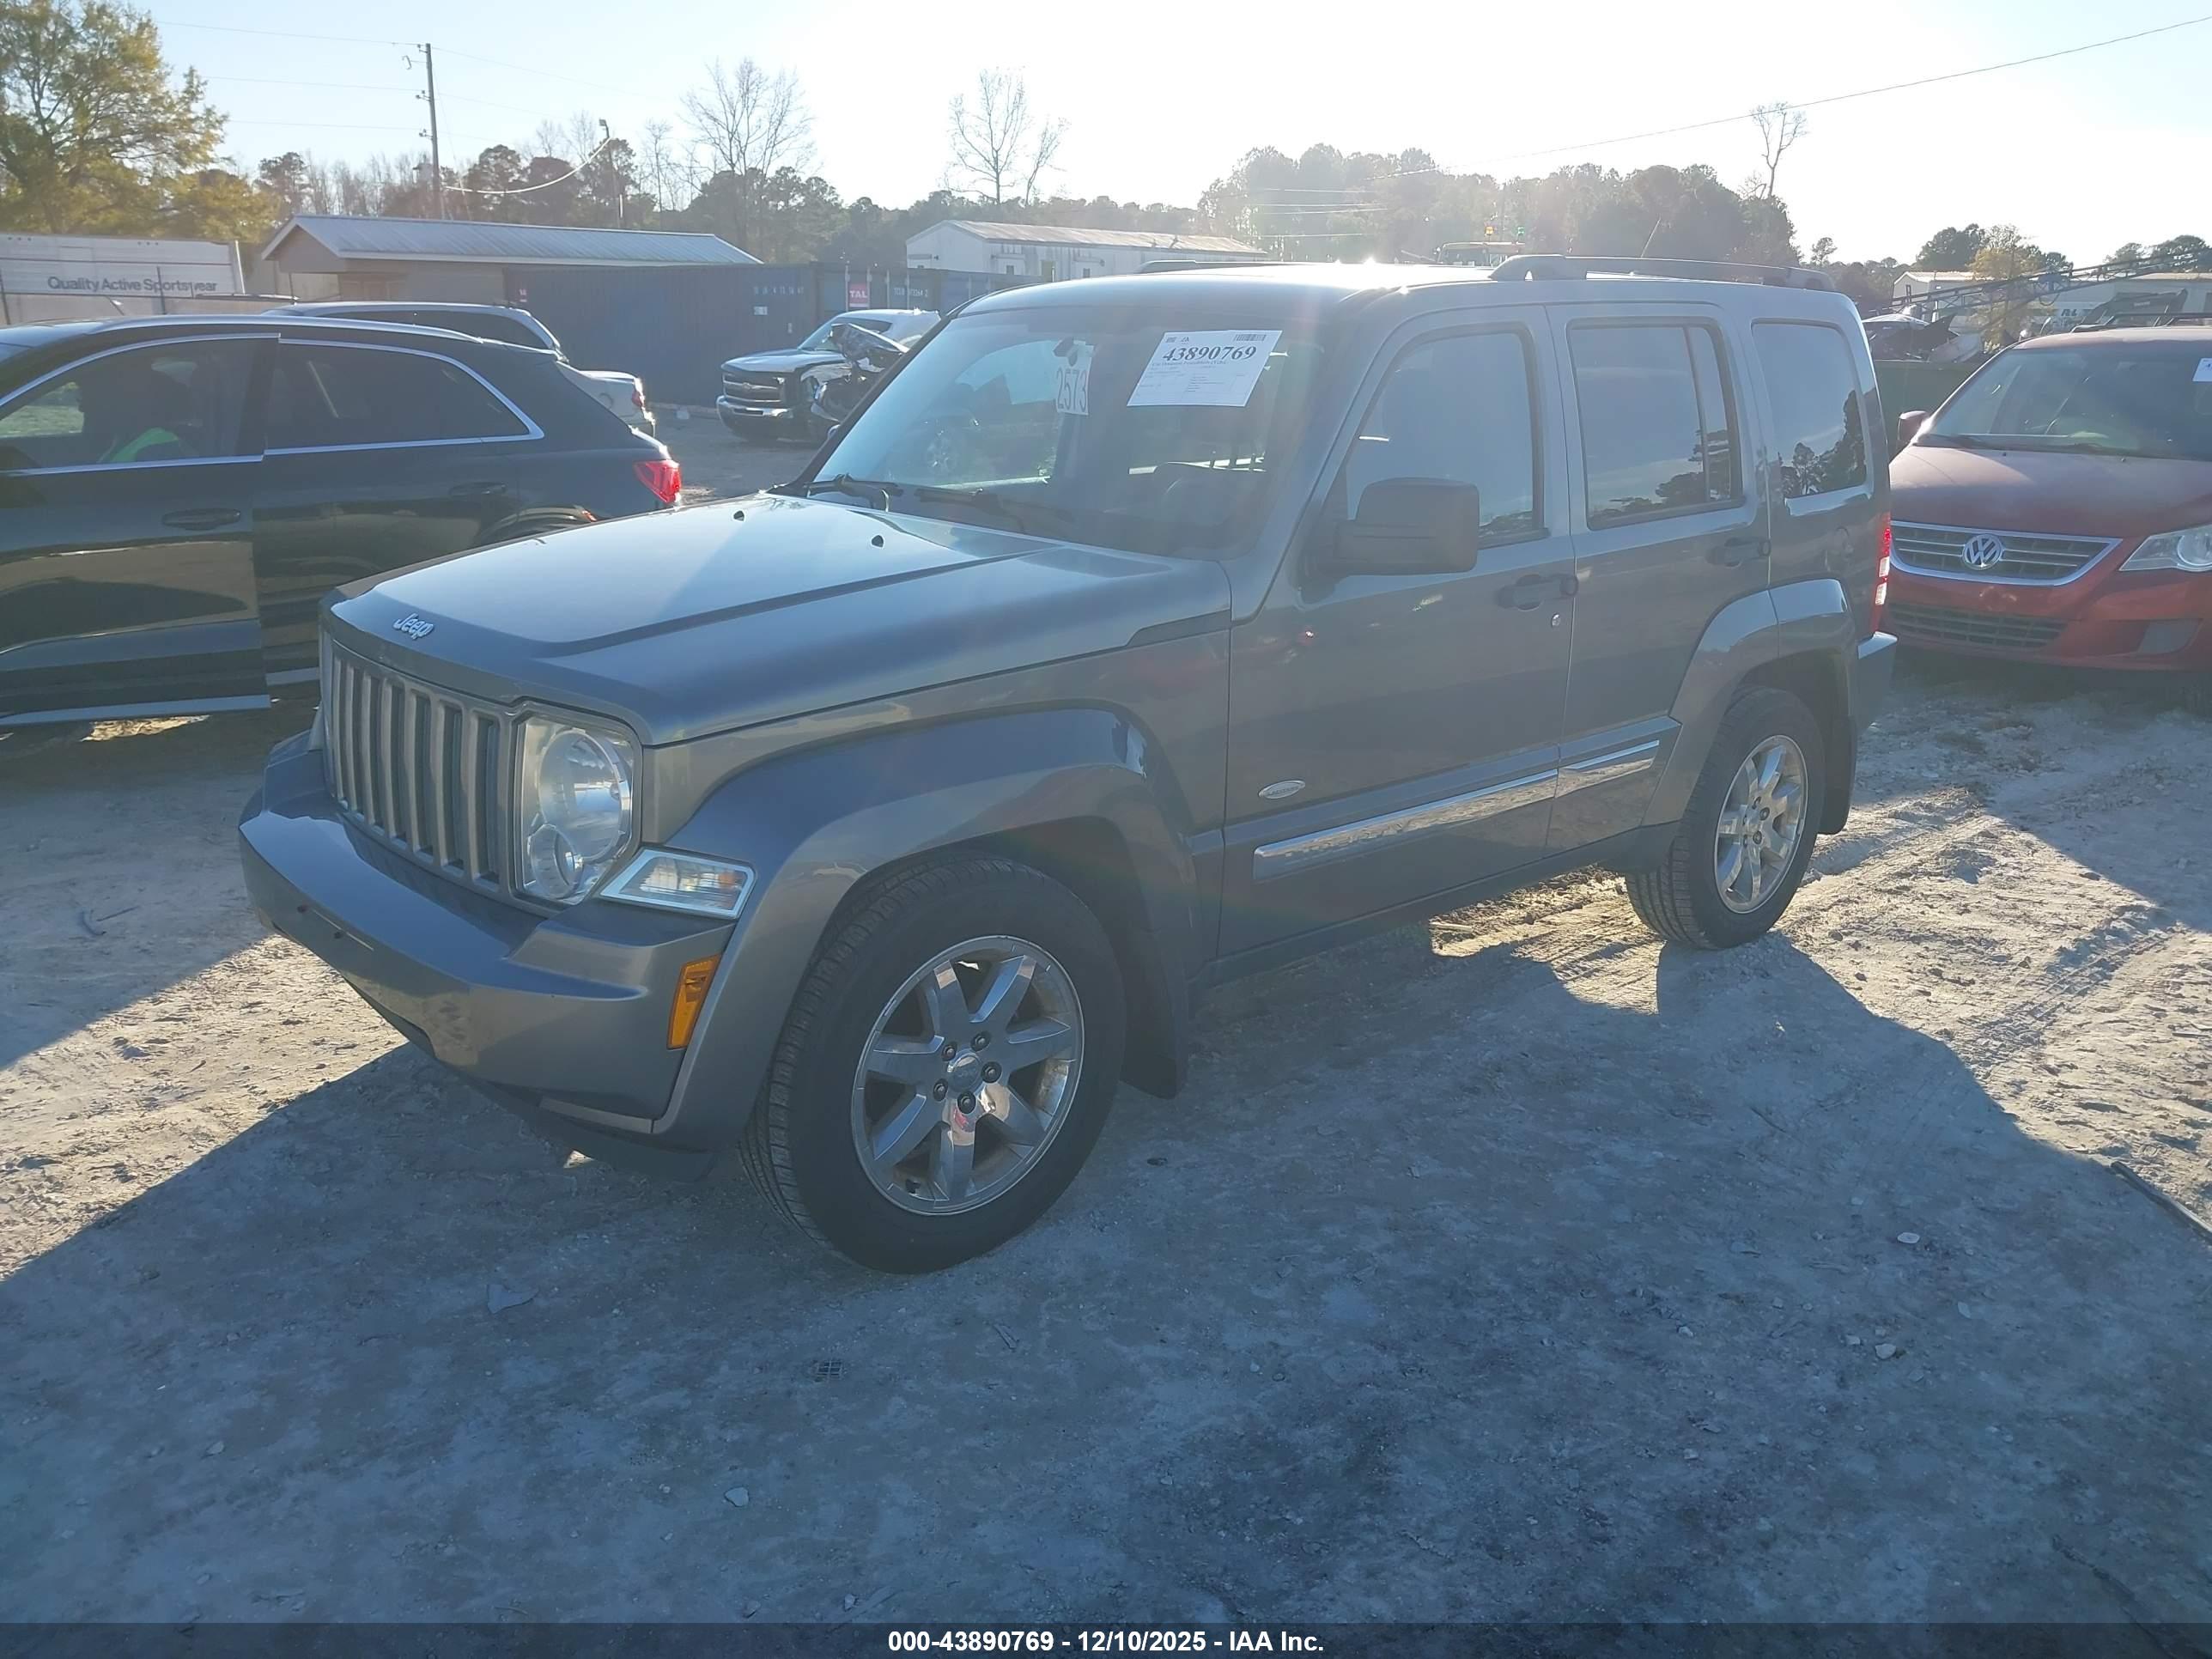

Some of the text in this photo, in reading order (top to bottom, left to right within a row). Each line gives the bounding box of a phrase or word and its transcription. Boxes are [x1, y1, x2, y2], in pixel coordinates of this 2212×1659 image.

[47, 276, 99, 292] Quality
[101, 278, 142, 291] Active
[849, 289, 868, 299] TAL
[1163, 345, 1256, 361] 43890769
[1056, 367, 1087, 411] 2573
[392, 612, 434, 641] Jeep
